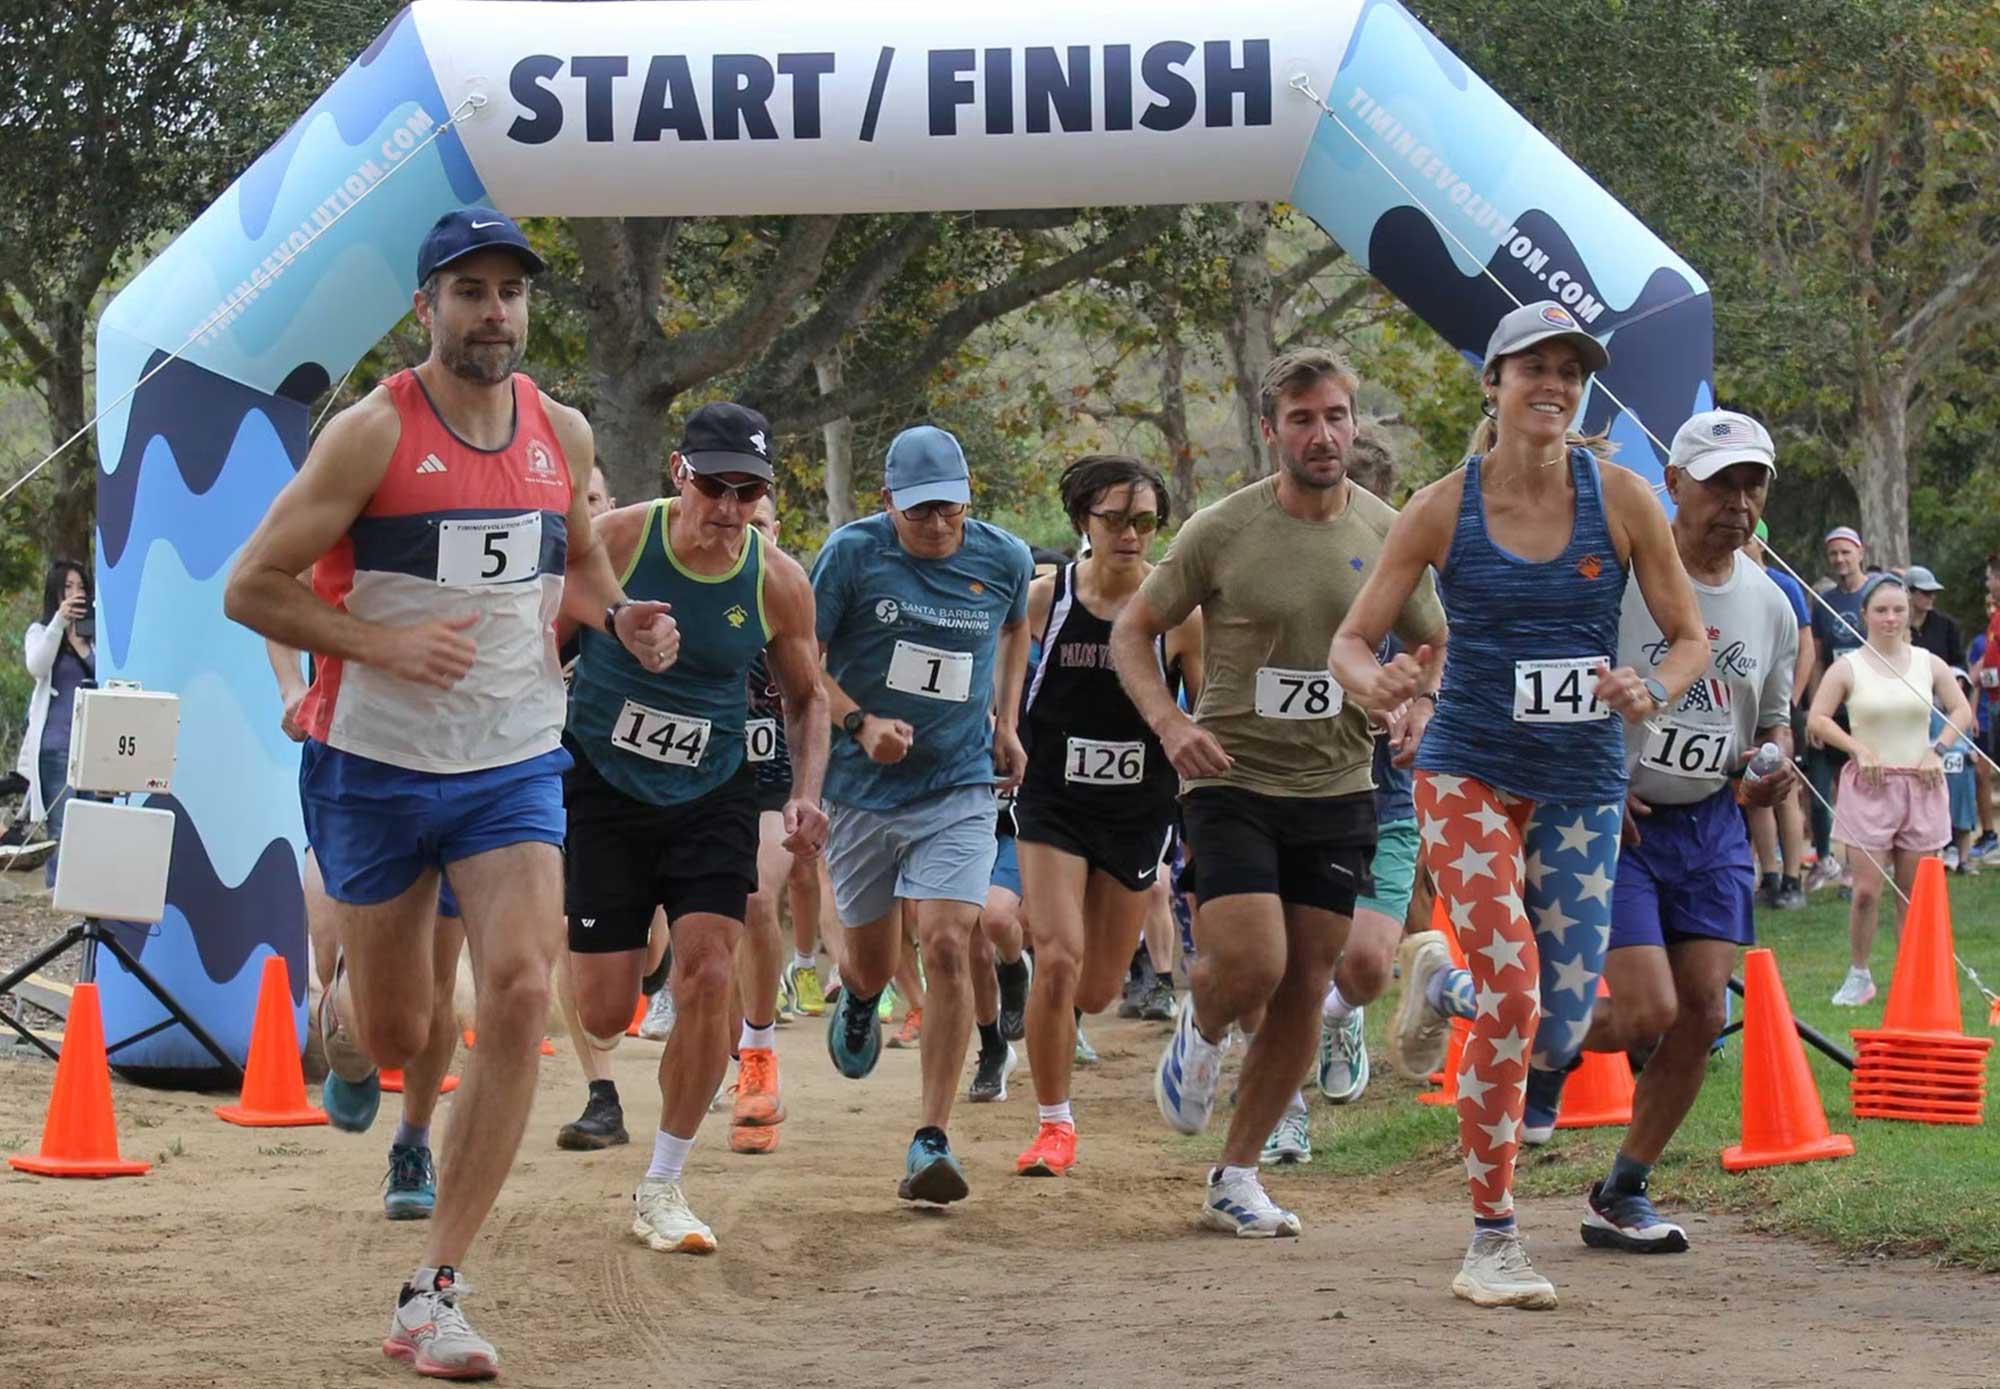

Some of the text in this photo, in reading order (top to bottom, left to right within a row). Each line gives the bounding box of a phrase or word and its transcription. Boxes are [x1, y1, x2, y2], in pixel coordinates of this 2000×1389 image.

[506, 38, 1272, 145] START / FINISH
[1348, 88, 1604, 323] TIMINGEVOLUTION.COM
[188, 106, 434, 346] TIMINGEVOLUTION.COM
[481, 531, 509, 578] 5
[900, 602, 990, 620] SANTA BARBARA
[938, 619, 989, 630] RUNNING
[1060, 643, 1097, 667] PALOS
[921, 659, 942, 693] 1
[1279, 678, 1330, 714] 78
[118, 736, 136, 756] 95
[621, 712, 702, 760] 144
[1650, 728, 1727, 772] 161
[1073, 747, 1140, 779] 126
